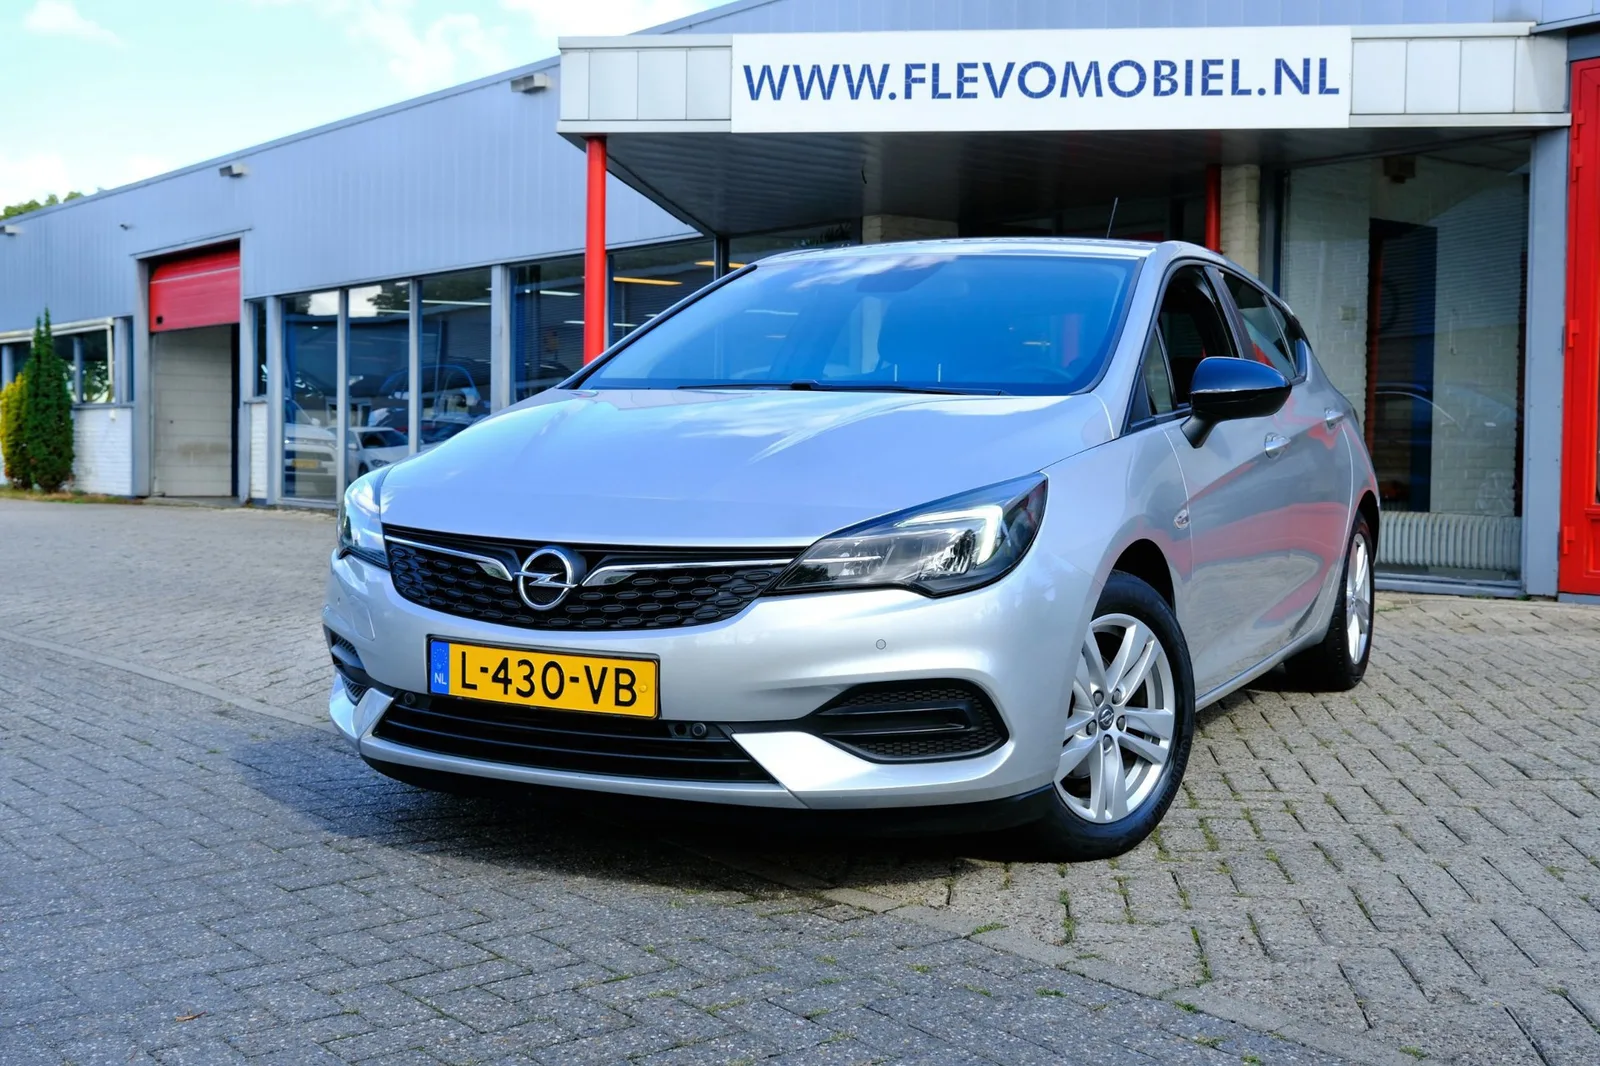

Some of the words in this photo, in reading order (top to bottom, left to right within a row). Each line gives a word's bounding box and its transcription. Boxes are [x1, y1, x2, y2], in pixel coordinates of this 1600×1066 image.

[743, 57, 1340, 101] WWW.FLEVOMOBIEL.NL
[434, 672, 447, 685] NL
[461, 651, 637, 707] L-430-VB
